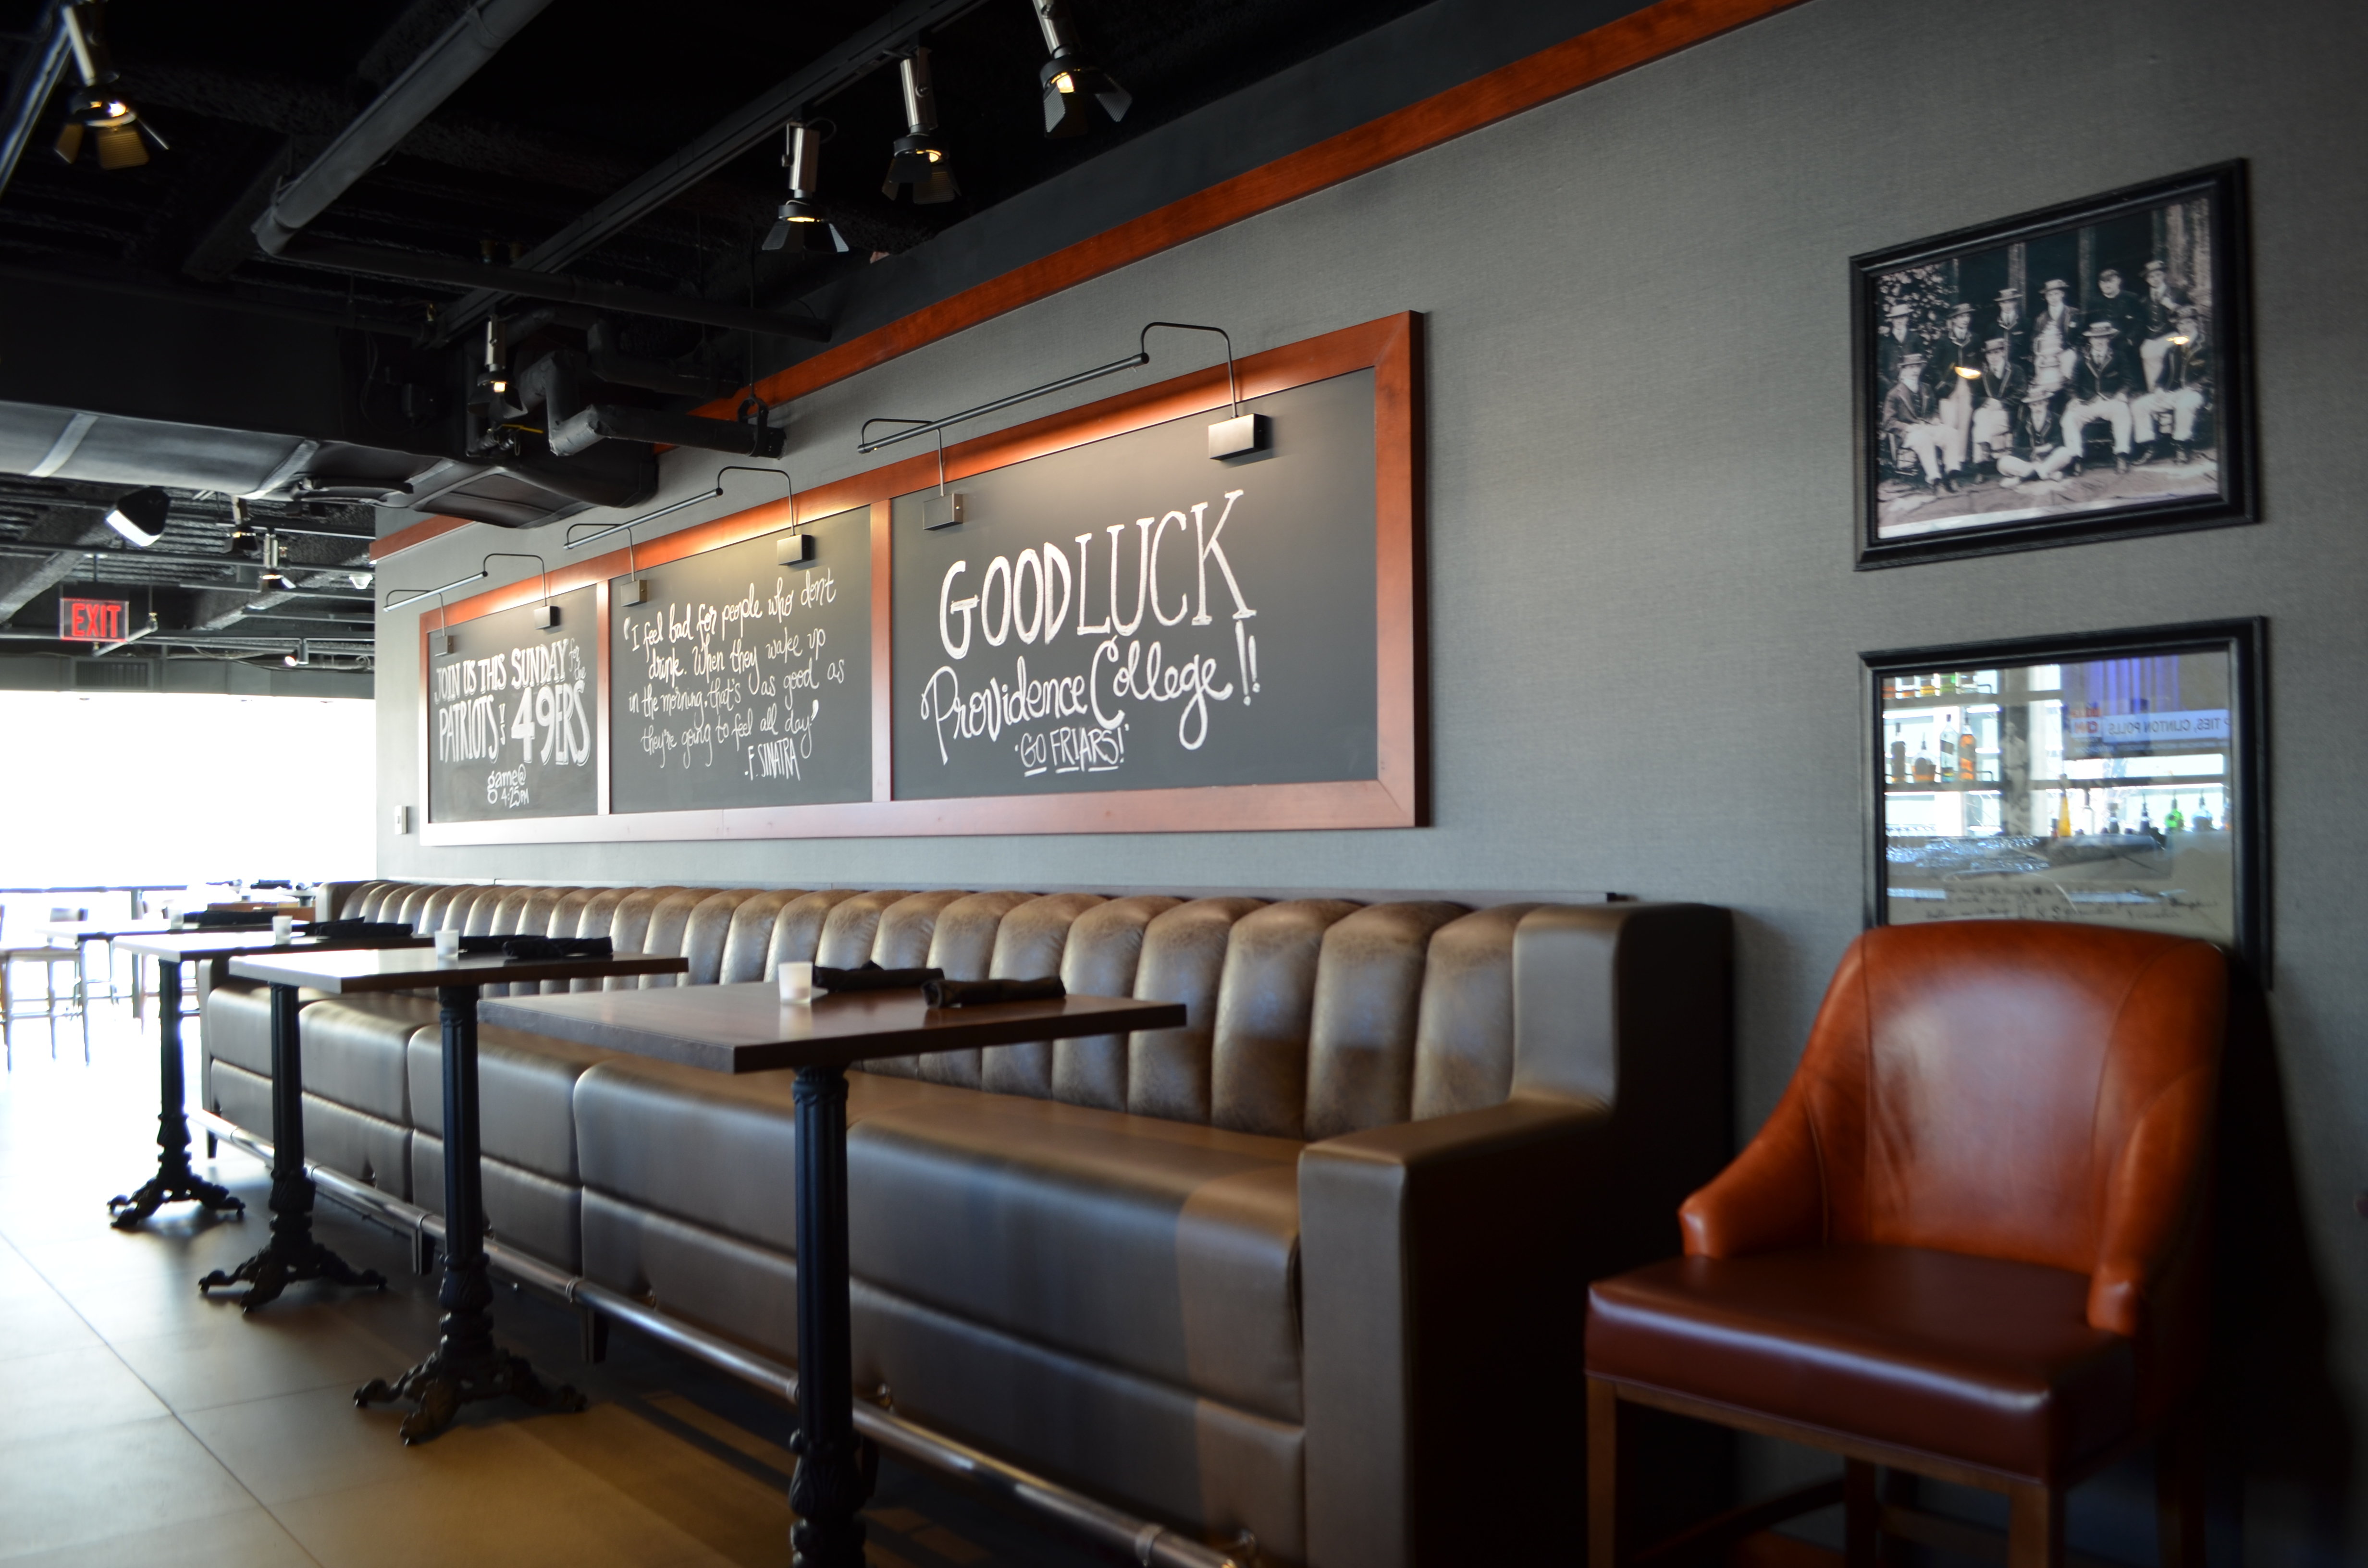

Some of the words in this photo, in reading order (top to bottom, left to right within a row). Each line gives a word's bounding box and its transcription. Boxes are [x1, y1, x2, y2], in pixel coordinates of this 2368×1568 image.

[939, 542, 1072, 660] GOOD
[1074, 489, 1257, 637] LUCK
[72, 603, 121, 637] EXIT
[643, 611, 664, 663] feel
[669, 603, 694, 643] bad
[696, 603, 717, 652] for
[722, 583, 763, 641] people
[768, 576, 794, 623] who
[434, 662, 461, 704] JOIN
[463, 660, 477, 695] US
[478, 653, 507, 694] THIS
[511, 638, 569, 690] SUNDAY
[629, 690, 640, 713] in
[641, 683, 659, 720] the
[707, 677, 741, 715] that's
[761, 675, 776, 697] as
[783, 657, 819, 710] good
[827, 659, 844, 684] as
[692, 633, 725, 684] When
[729, 638, 760, 695] they
[765, 627, 803, 663] wake
[807, 628, 826, 661] up
[439, 694, 500, 764] PATRIOTS
[511, 680, 591, 766] 49ERS
[681, 723, 713, 769] going
[715, 715, 729, 744] to
[731, 708, 753, 751] feel
[760, 702, 778, 735] all
[921, 656, 1087, 765] Providence
[758, 737, 801, 781] SINATRA
